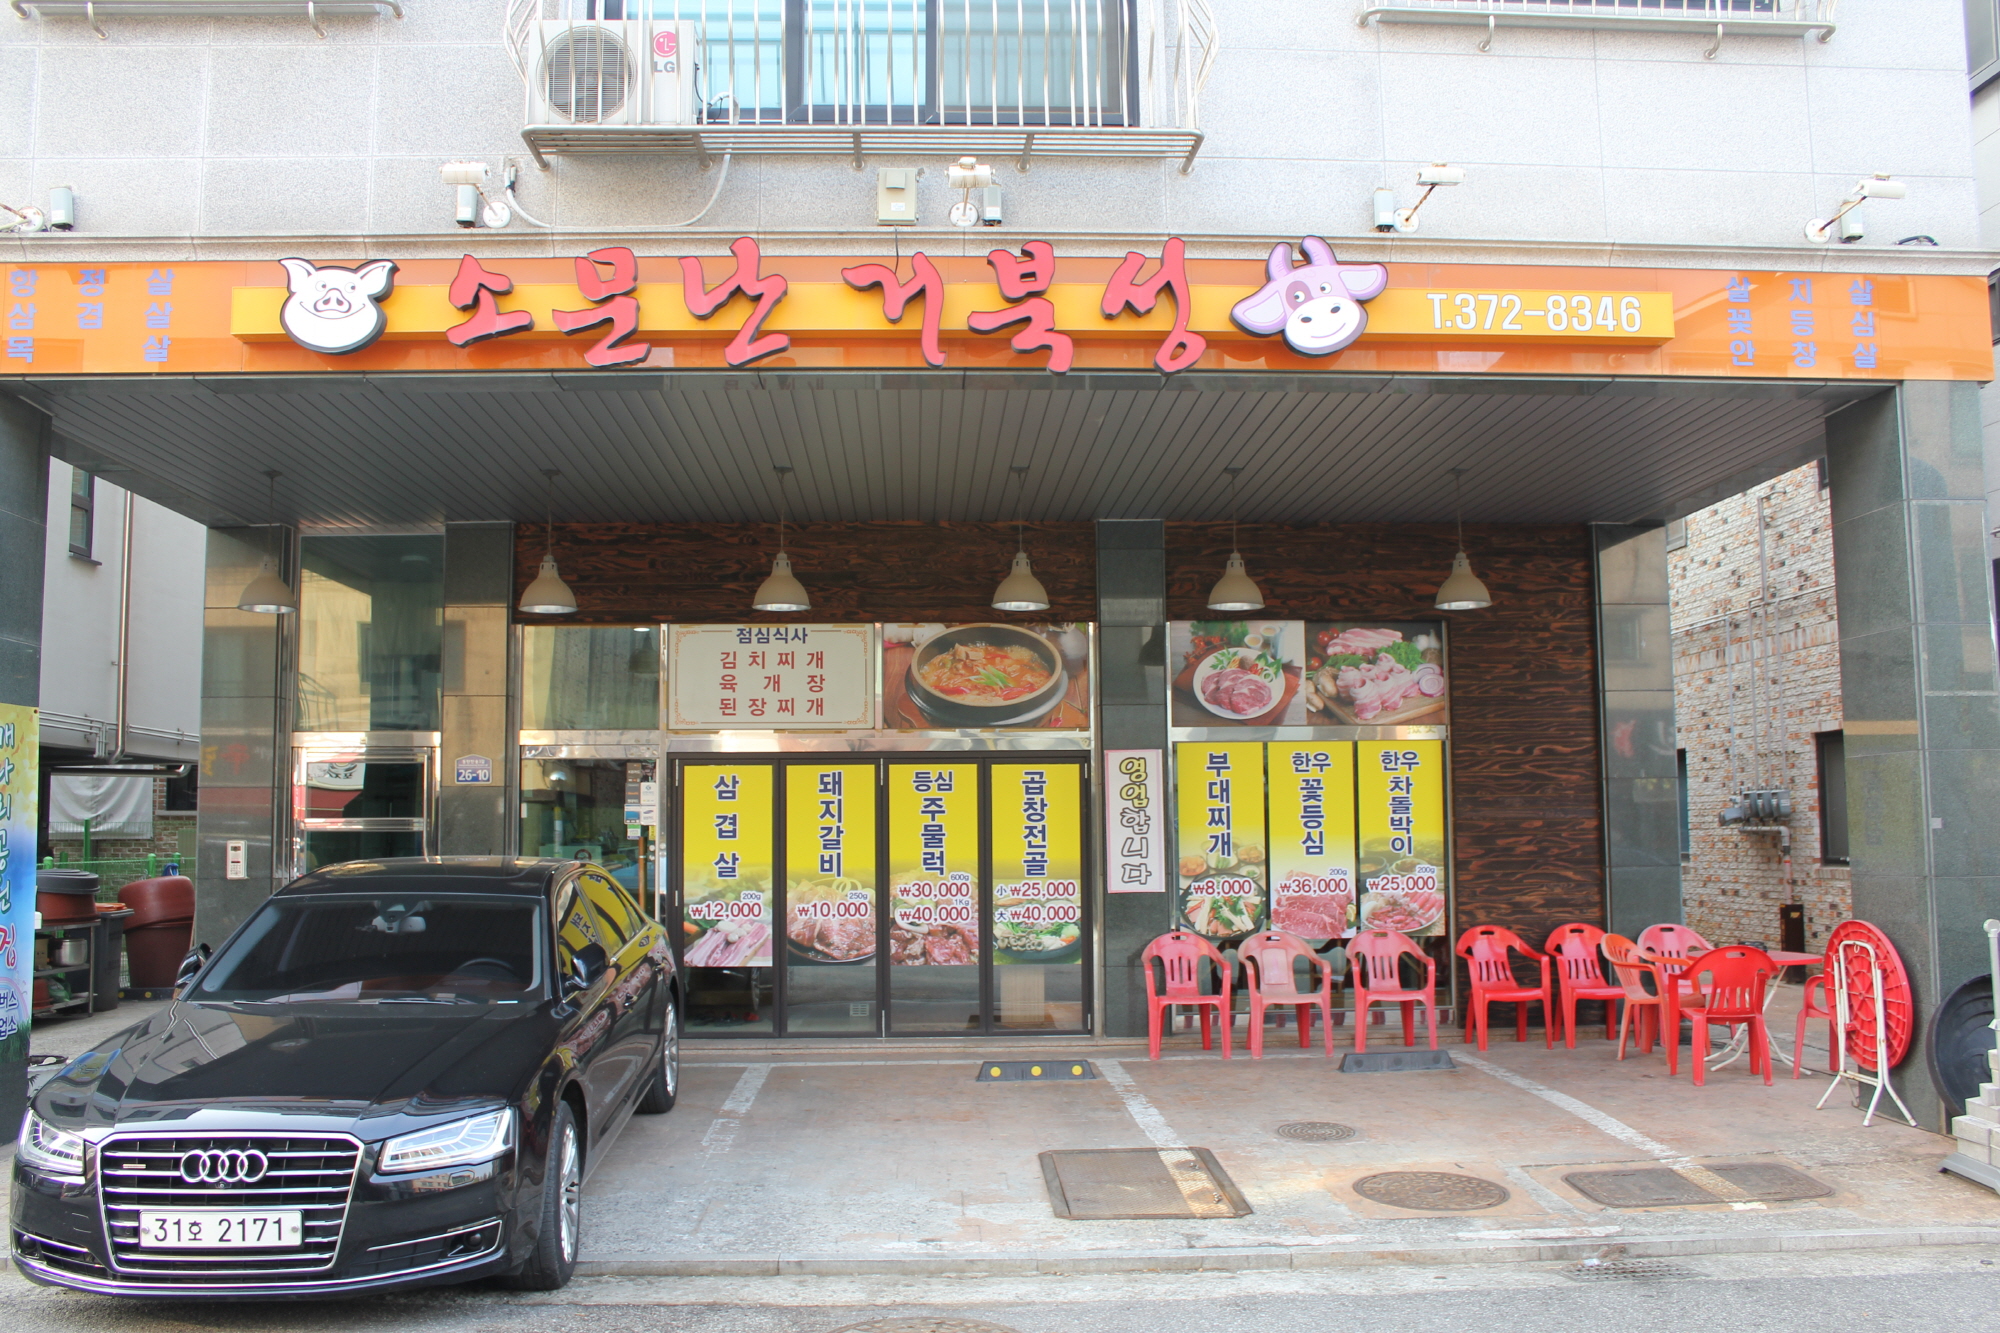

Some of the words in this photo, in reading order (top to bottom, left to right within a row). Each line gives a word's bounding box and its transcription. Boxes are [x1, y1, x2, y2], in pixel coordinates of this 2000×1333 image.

[653, 61, 676, 73] LG
[445, 236, 791, 368] 소문난
[841, 236, 1207, 376] 거북성
[1426, 292, 1642, 333] T.372-8346
[736, 627, 808, 645] 점심식사
[1291, 752, 1332, 773] 한우
[1381, 750, 1420, 772] 한우
[458, 769, 489, 781] 26-10
[912, 771, 953, 793] 등심
[1205, 752, 1232, 858] 부대찌개
[818, 771, 844, 878] 돼지갈비
[1021, 771, 1048, 877] 곱창전골
[1119, 756, 1153, 886] 영업합니다
[1299, 778, 1325, 856] 꽃등심
[1388, 776, 1414, 856] 차돌박이
[713, 775, 740, 878] 삼겹살
[920, 797, 946, 876] 주물럭
[950, 873, 970, 881] 600g
[1329, 868, 1348, 877] 200g
[1417, 866, 1436, 875] 200g
[899, 882, 970, 899] ₩30,000
[996, 886, 1007, 897] 小
[1010, 882, 1076, 899] ₩25,000
[1192, 879, 1251, 897] ₩8,000
[1279, 878, 1348, 895] ₩36,000
[1368, 875, 1436, 893] ₩25,000
[742, 892, 761, 901] 200g
[849, 892, 868, 901] 250g
[690, 902, 762, 919] ₩12,000
[797, 902, 868, 919] ₩10,000
[899, 906, 970, 924] ₩40,000
[996, 910, 1008, 922] 大
[1010, 905, 1076, 923] ₩40,000
[154, 1217, 202, 1242] 31호
[218, 1217, 282, 1242] 2171
